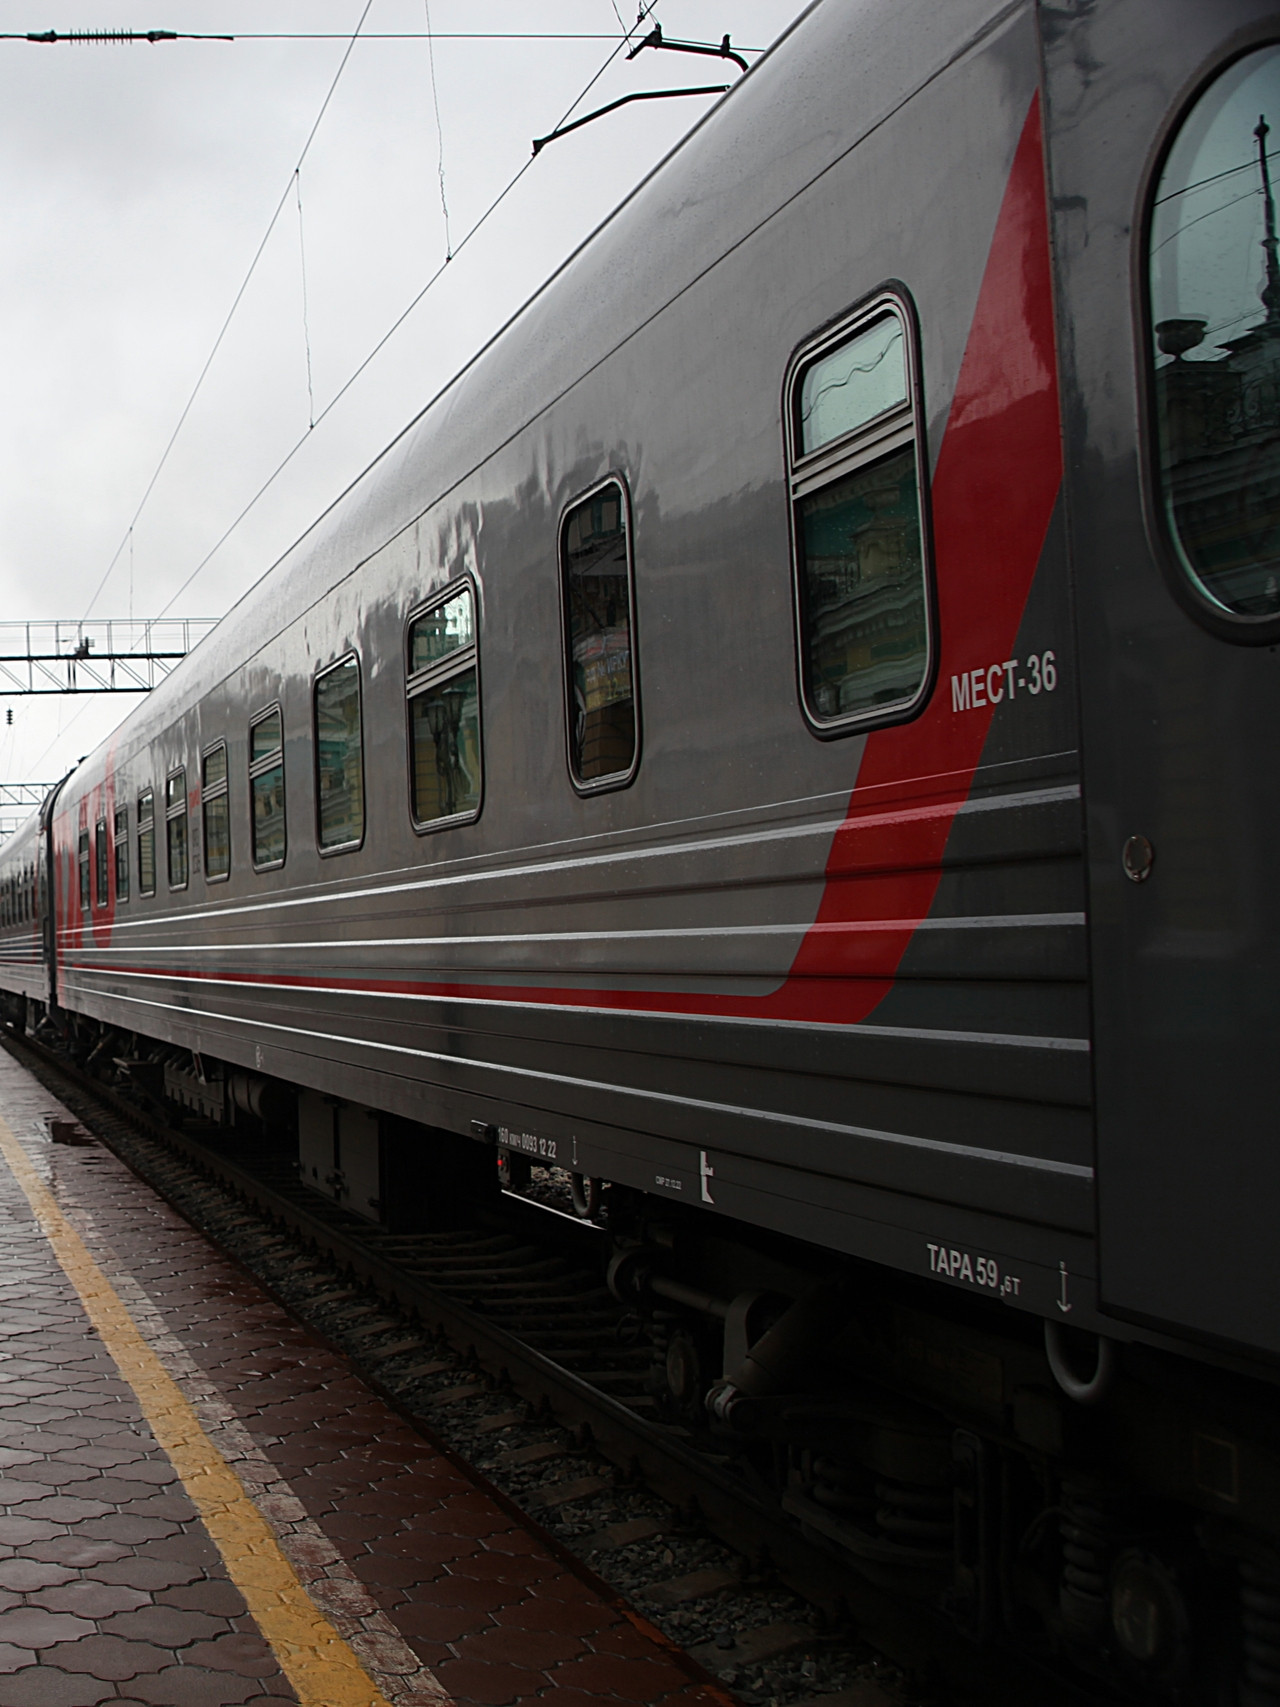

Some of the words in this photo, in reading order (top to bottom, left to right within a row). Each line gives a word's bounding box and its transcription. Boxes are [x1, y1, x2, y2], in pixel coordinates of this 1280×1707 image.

[951, 650, 1057, 713] МЕСТ-36
[547, 1140, 557, 1159] 22
[926, 1243, 975, 1283] ТАРА
